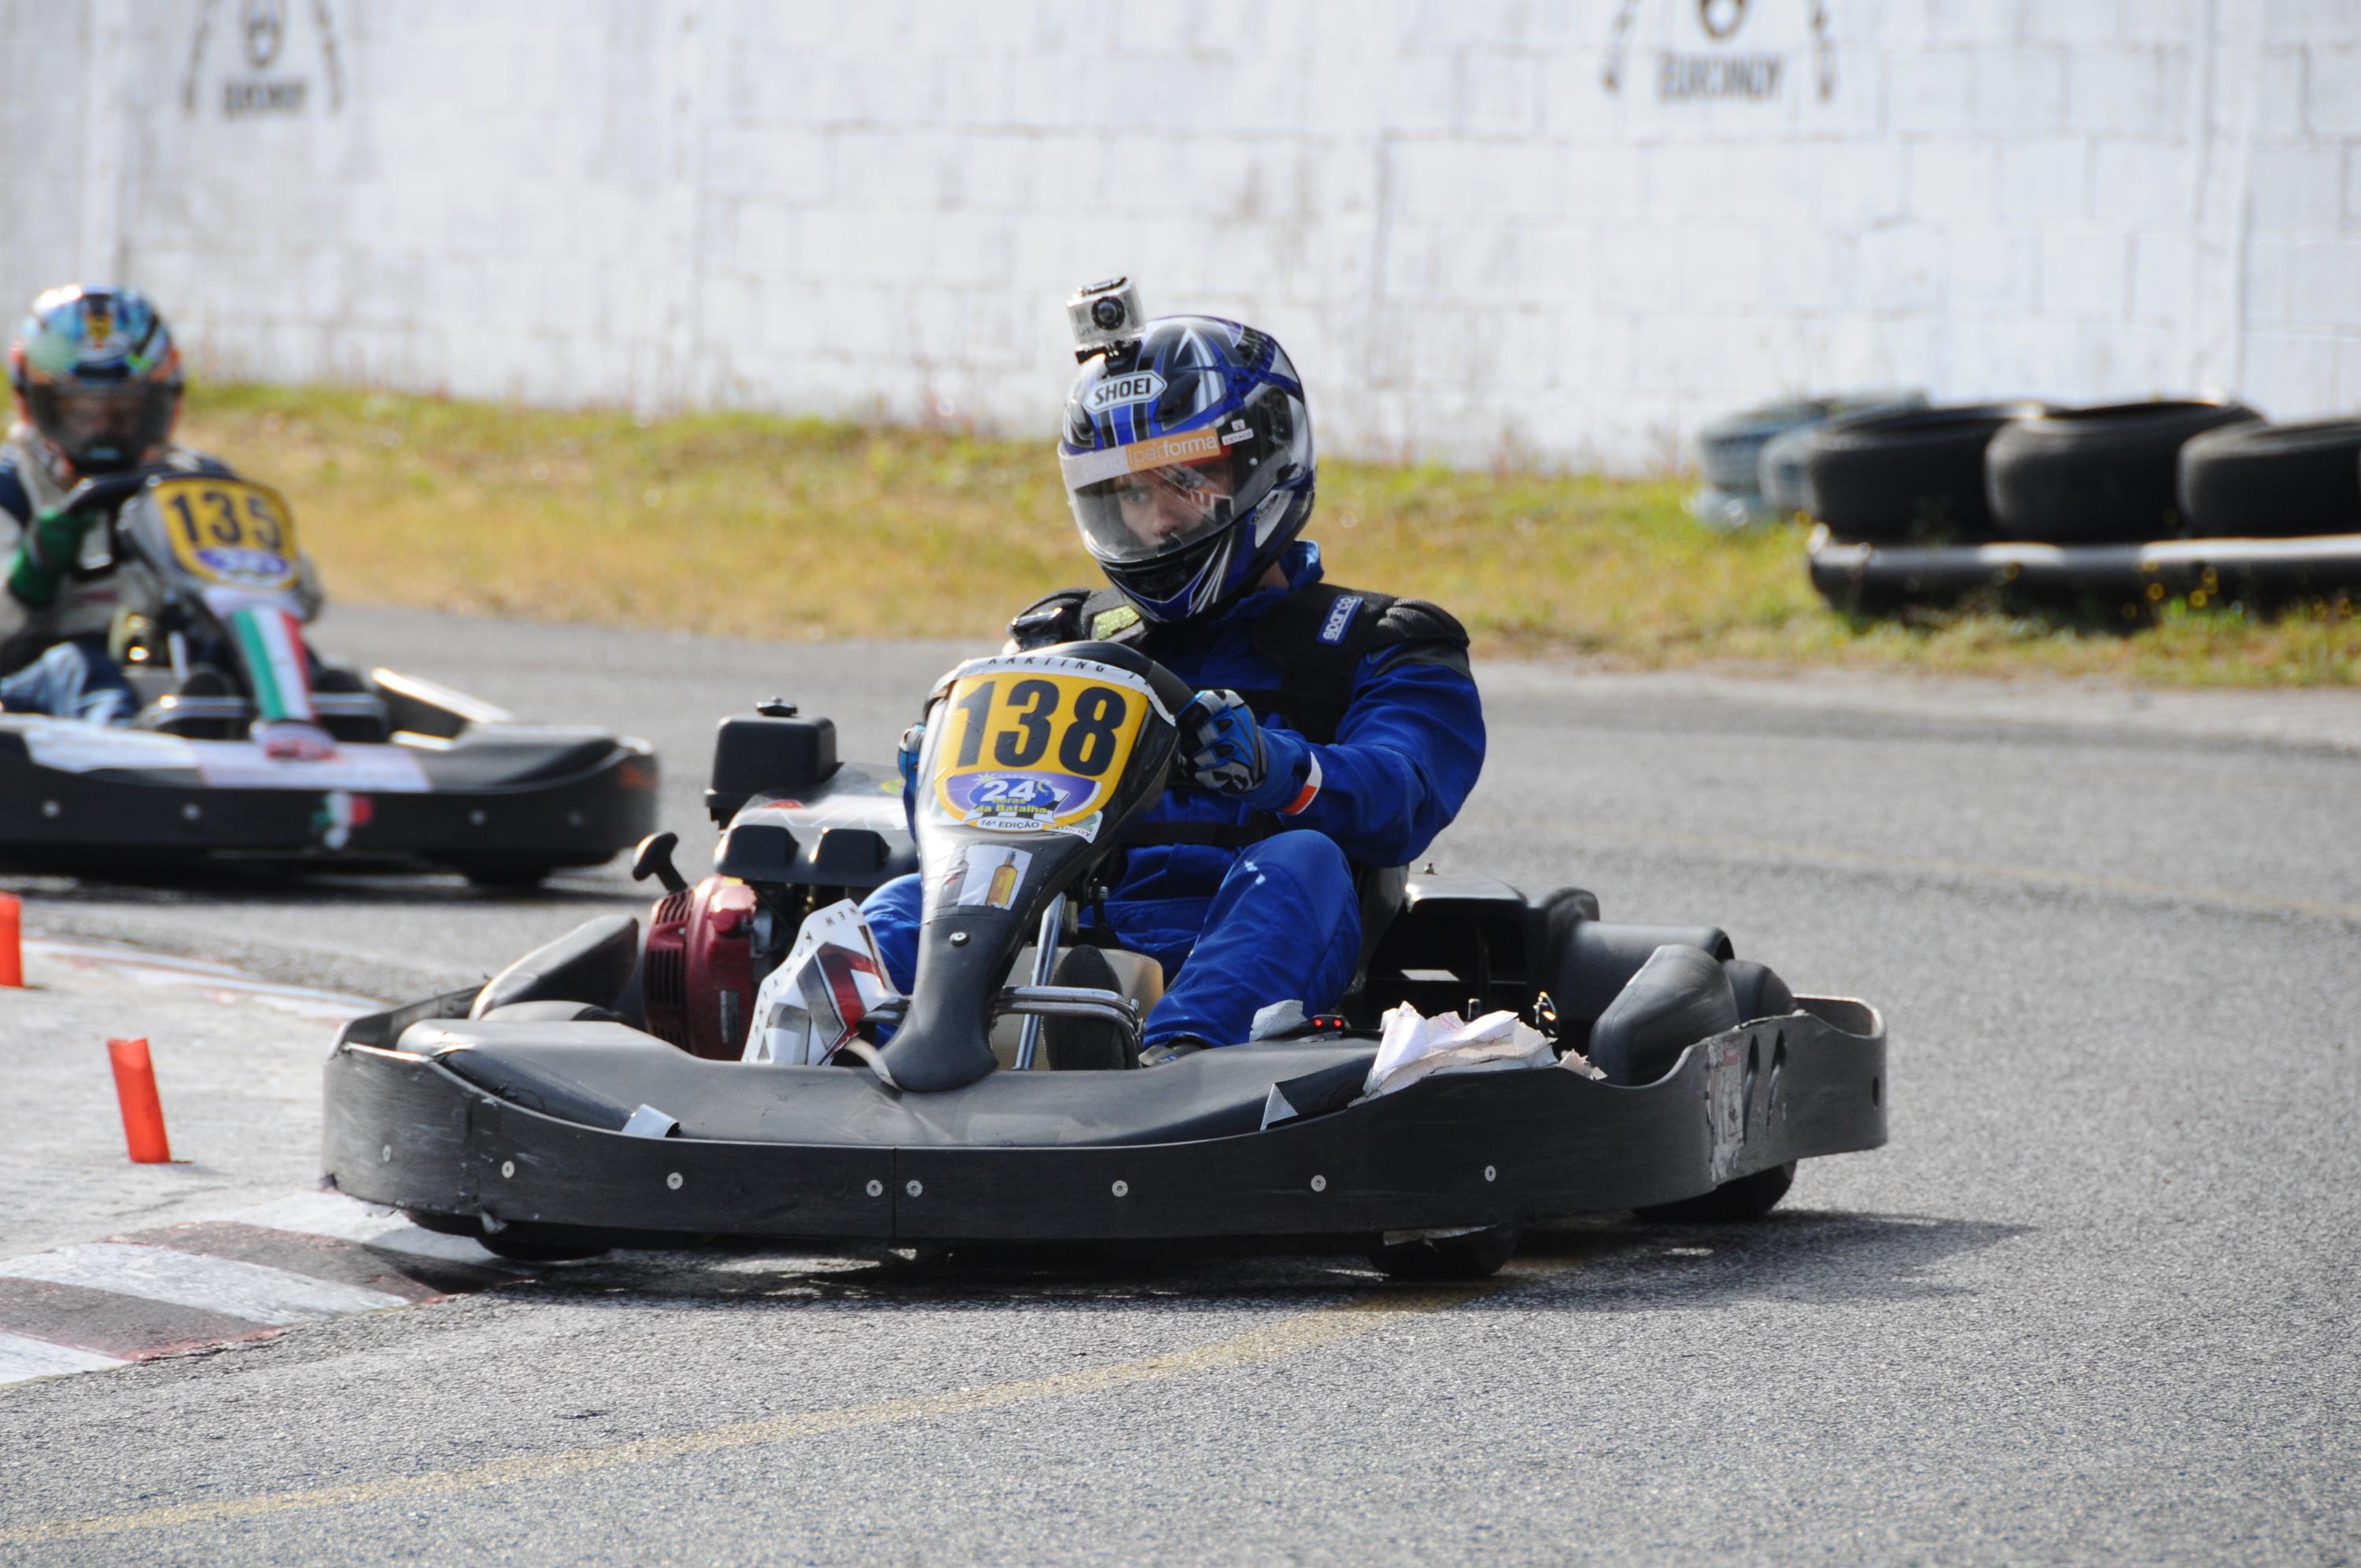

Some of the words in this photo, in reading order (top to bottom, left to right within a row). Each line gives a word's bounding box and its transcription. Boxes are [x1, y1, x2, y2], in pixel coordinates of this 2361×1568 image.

[1094, 378, 1151, 405] SHOEI
[171, 490, 282, 550] 135
[956, 680, 1127, 777] 138
[980, 780, 1037, 802] 24
[996, 805, 1048, 815] Batalha
[998, 820, 1040, 829] EDIÇÃO
